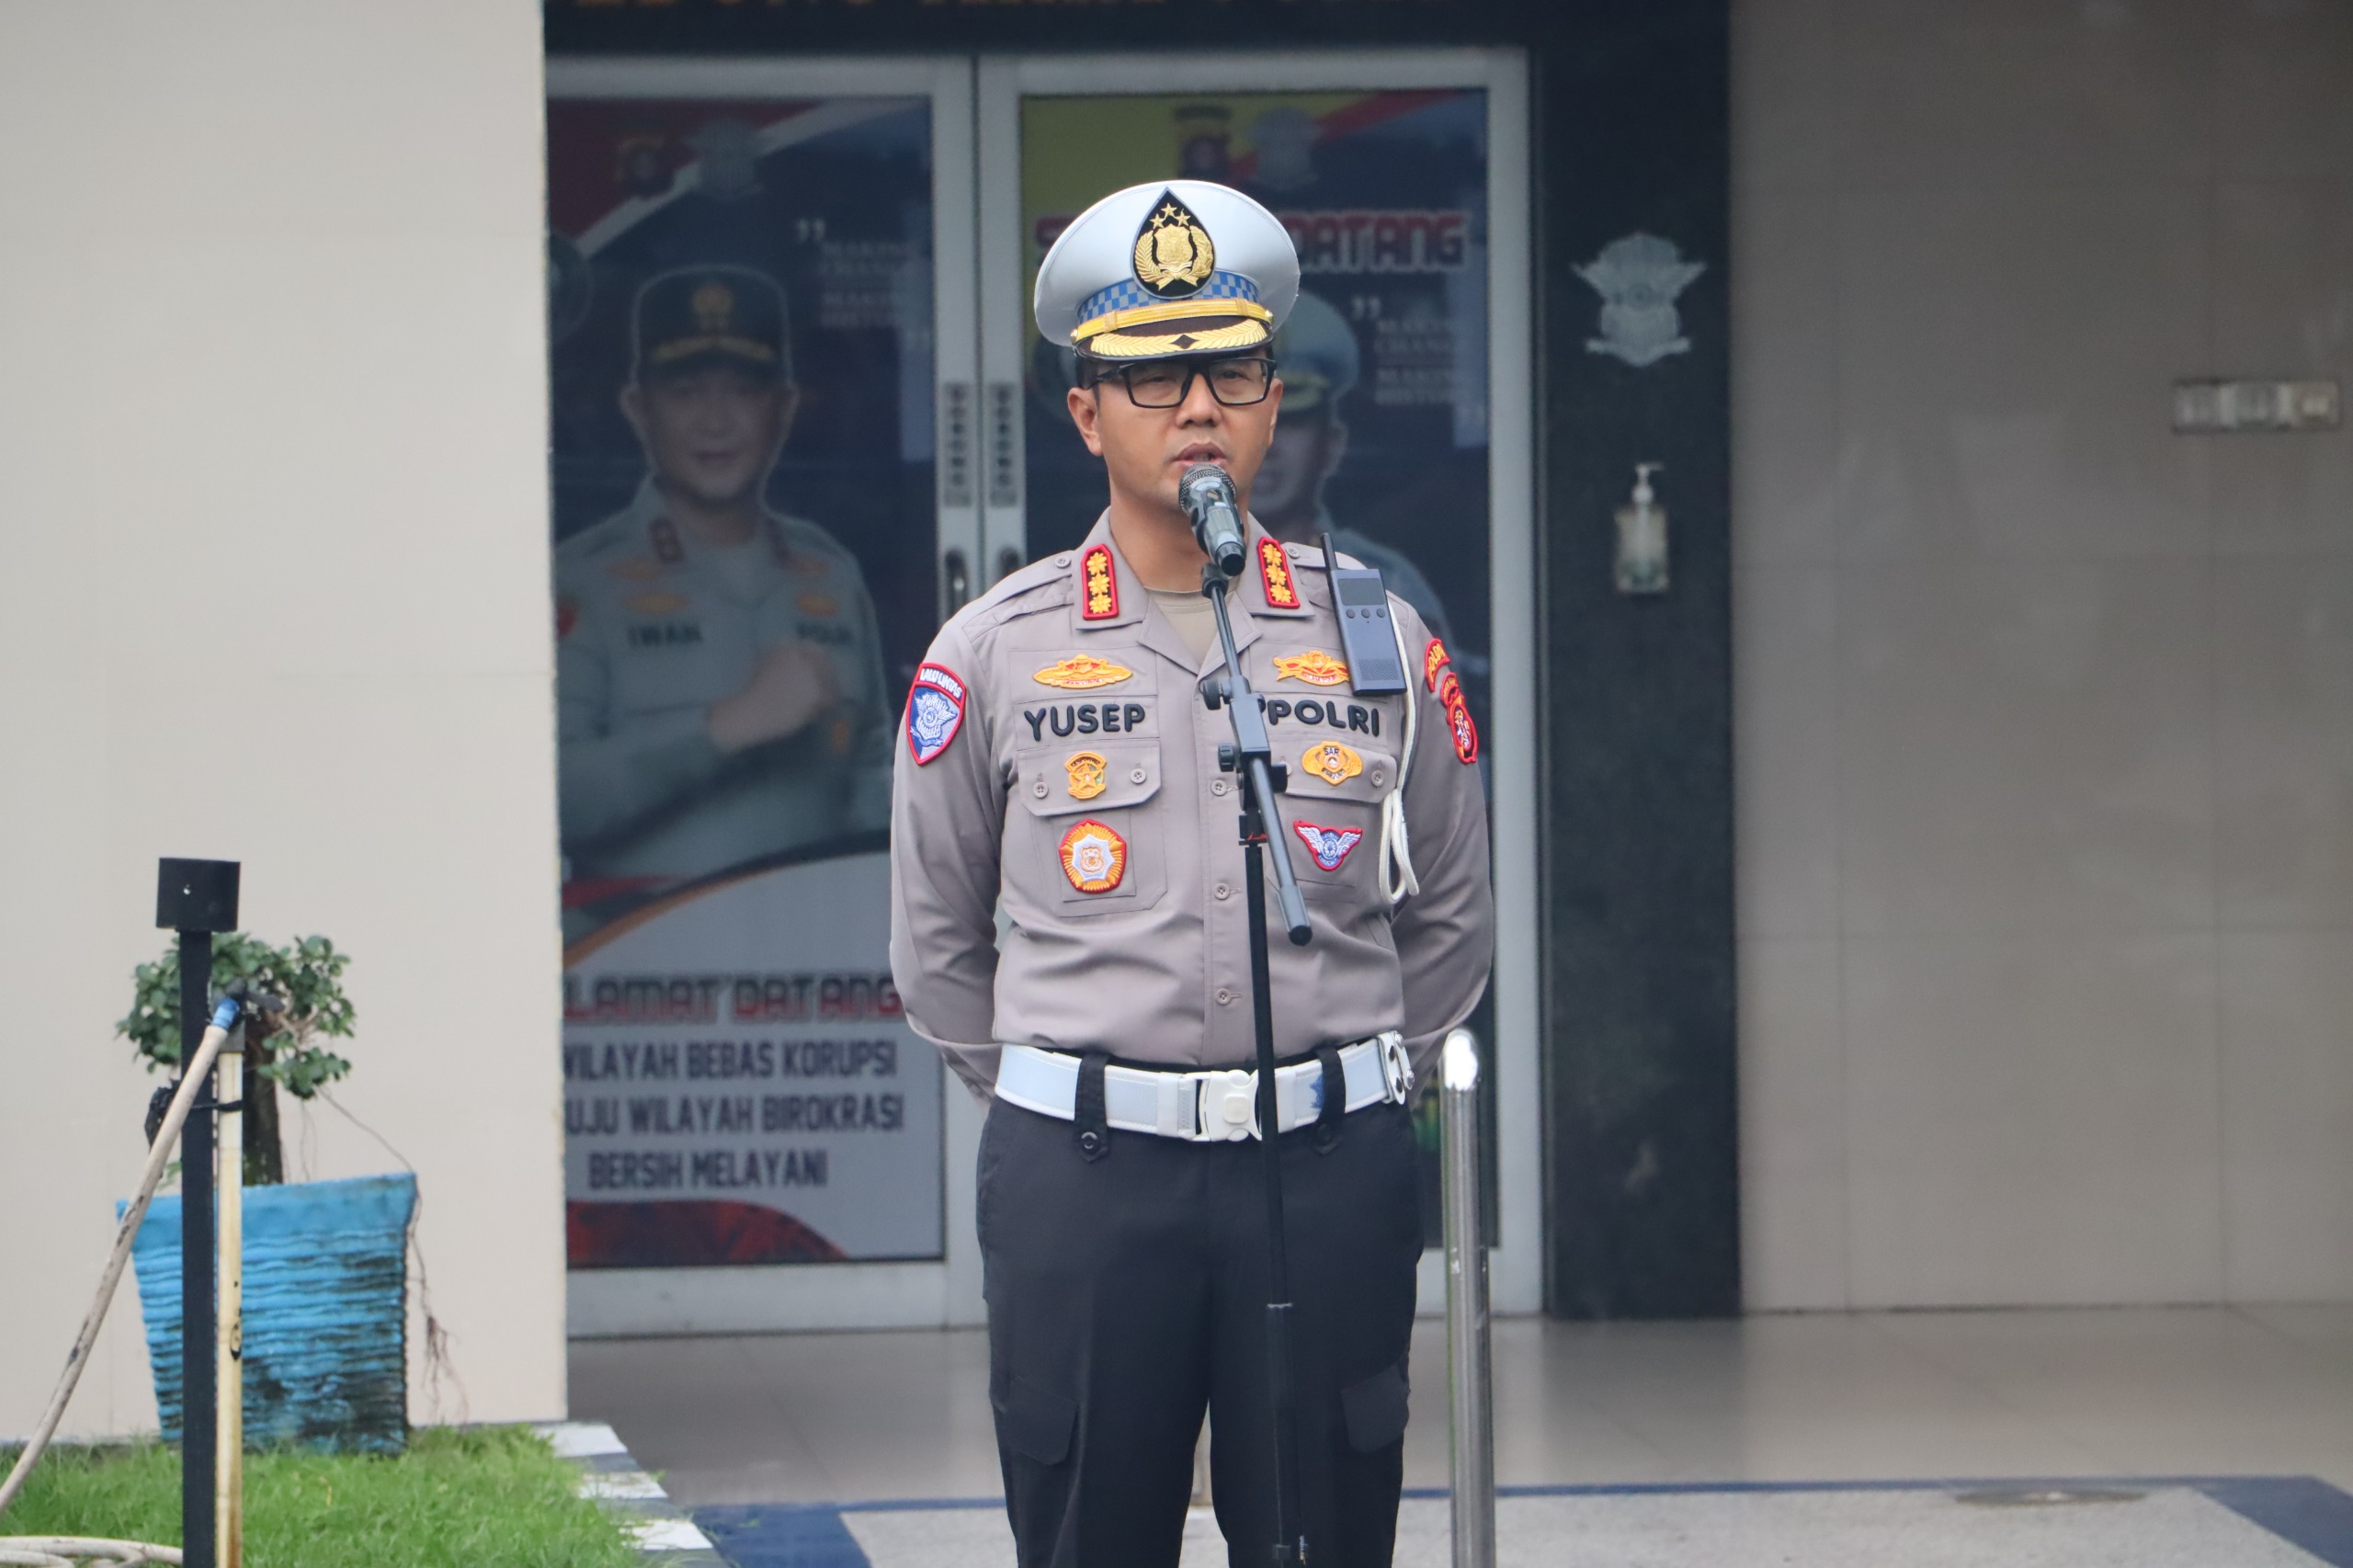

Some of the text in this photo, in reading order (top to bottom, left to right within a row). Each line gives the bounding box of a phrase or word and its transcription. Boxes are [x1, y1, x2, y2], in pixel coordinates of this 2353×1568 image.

[919, 668, 963, 699] LALU LINTAS
[1023, 703, 1146, 743] YUSEP
[1267, 699, 1380, 737] POLRI
[1324, 747, 1340, 756] SAR
[733, 974, 904, 1022] DATANG
[687, 1040, 775, 1080] BEBAS
[781, 1040, 899, 1079] KORUPSI
[627, 1095, 754, 1134] WILAYAH
[761, 1093, 905, 1133] BIROKRASI
[588, 1149, 829, 1190] BERSIH MELAYANI
